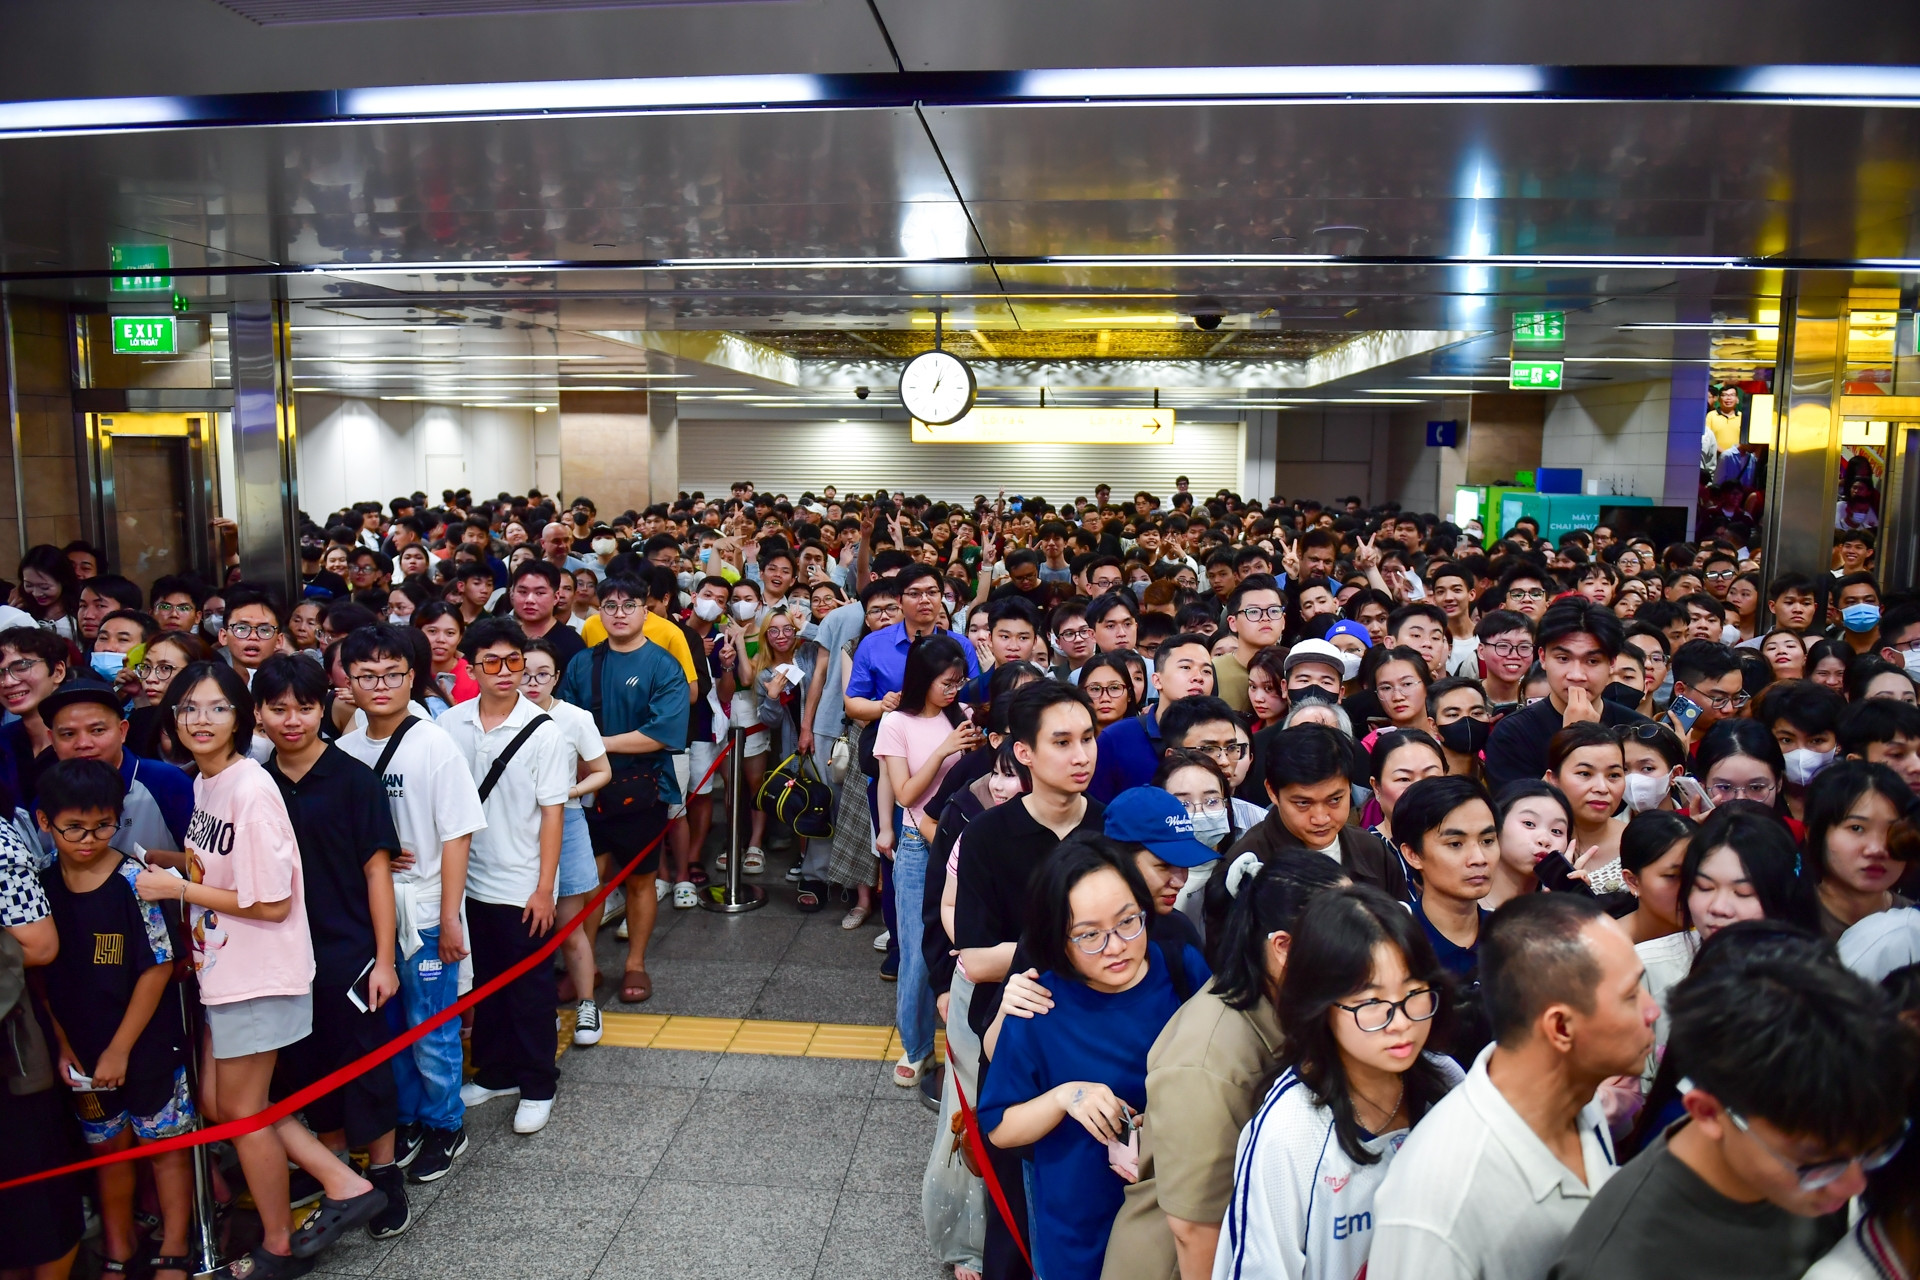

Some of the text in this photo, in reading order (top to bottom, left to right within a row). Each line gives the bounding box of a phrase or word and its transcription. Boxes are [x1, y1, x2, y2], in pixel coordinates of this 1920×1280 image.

[123, 323, 164, 339] EXIT
[1513, 368, 1530, 377] EXIT
[1572, 512, 1592, 521] MÁY
[1550, 522, 1572, 530] CHAI
[388, 789, 404, 798] ACE
[1333, 1211, 1371, 1240] Em
